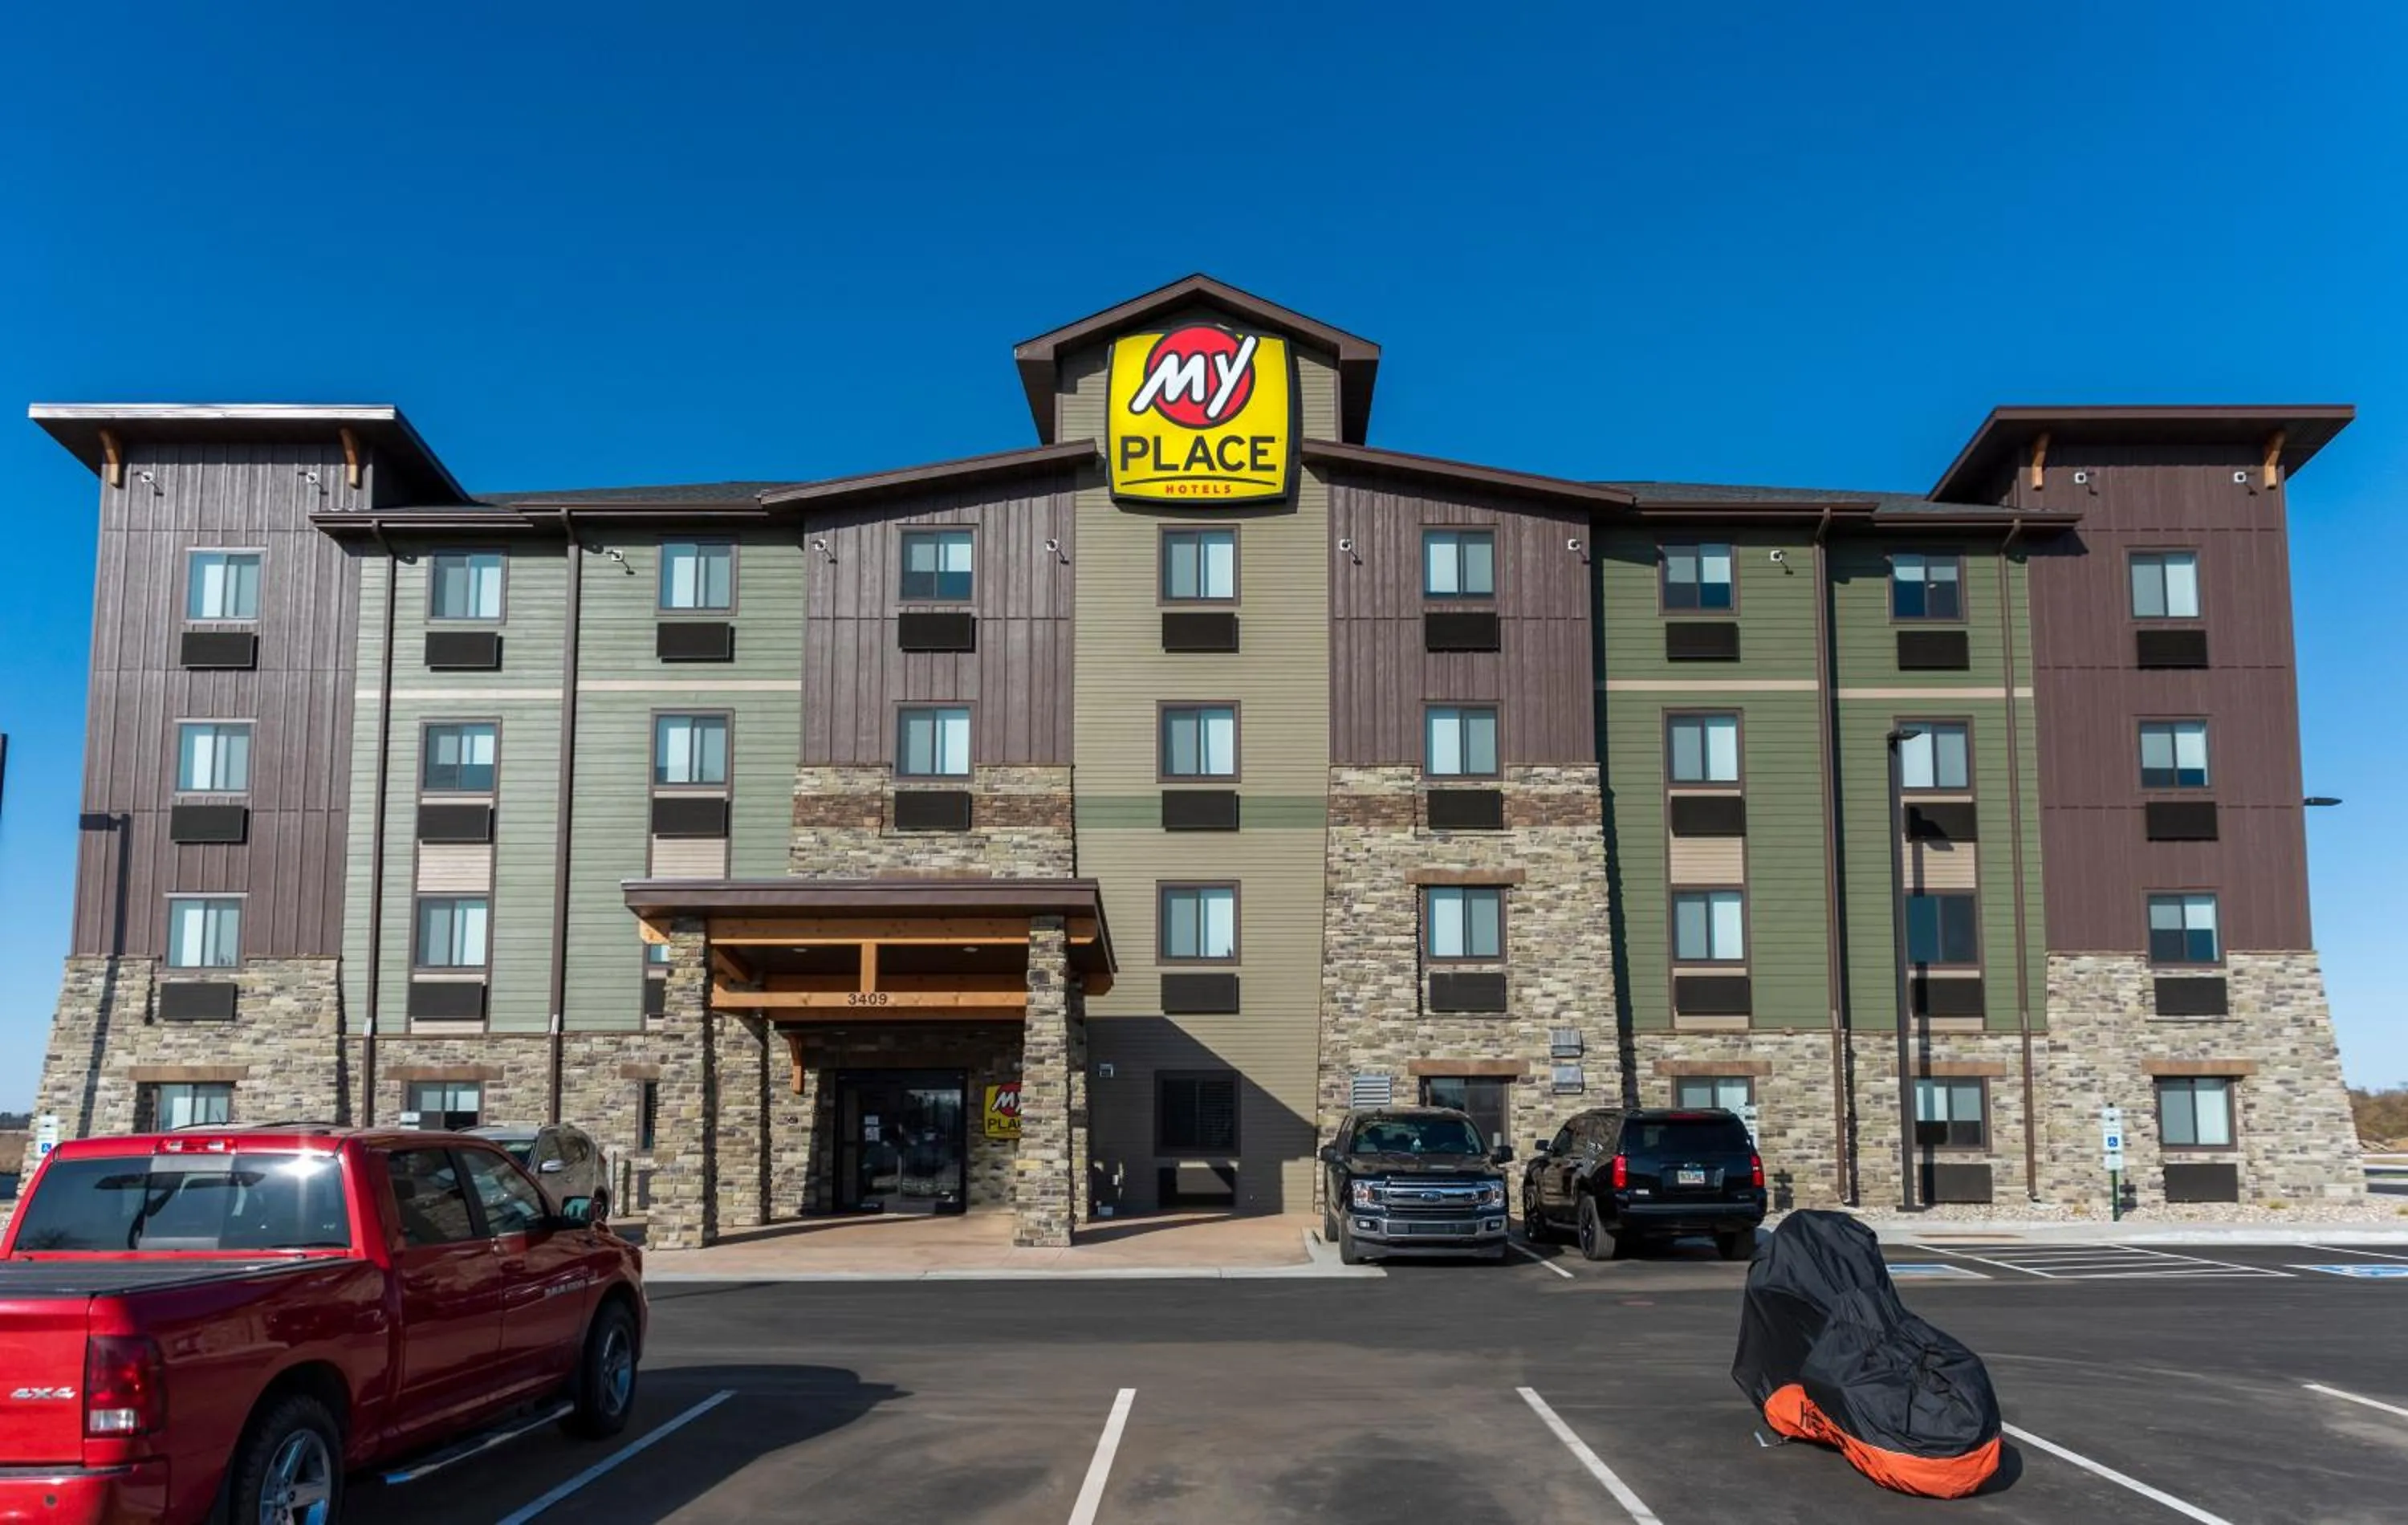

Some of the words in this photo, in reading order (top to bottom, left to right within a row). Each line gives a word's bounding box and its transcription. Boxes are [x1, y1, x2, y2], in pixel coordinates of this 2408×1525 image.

[1121, 436, 1276, 472] PLACE
[1165, 484, 1232, 494] HOTELS
[848, 993, 888, 1006] 3409
[988, 1119, 1022, 1130] PLA
